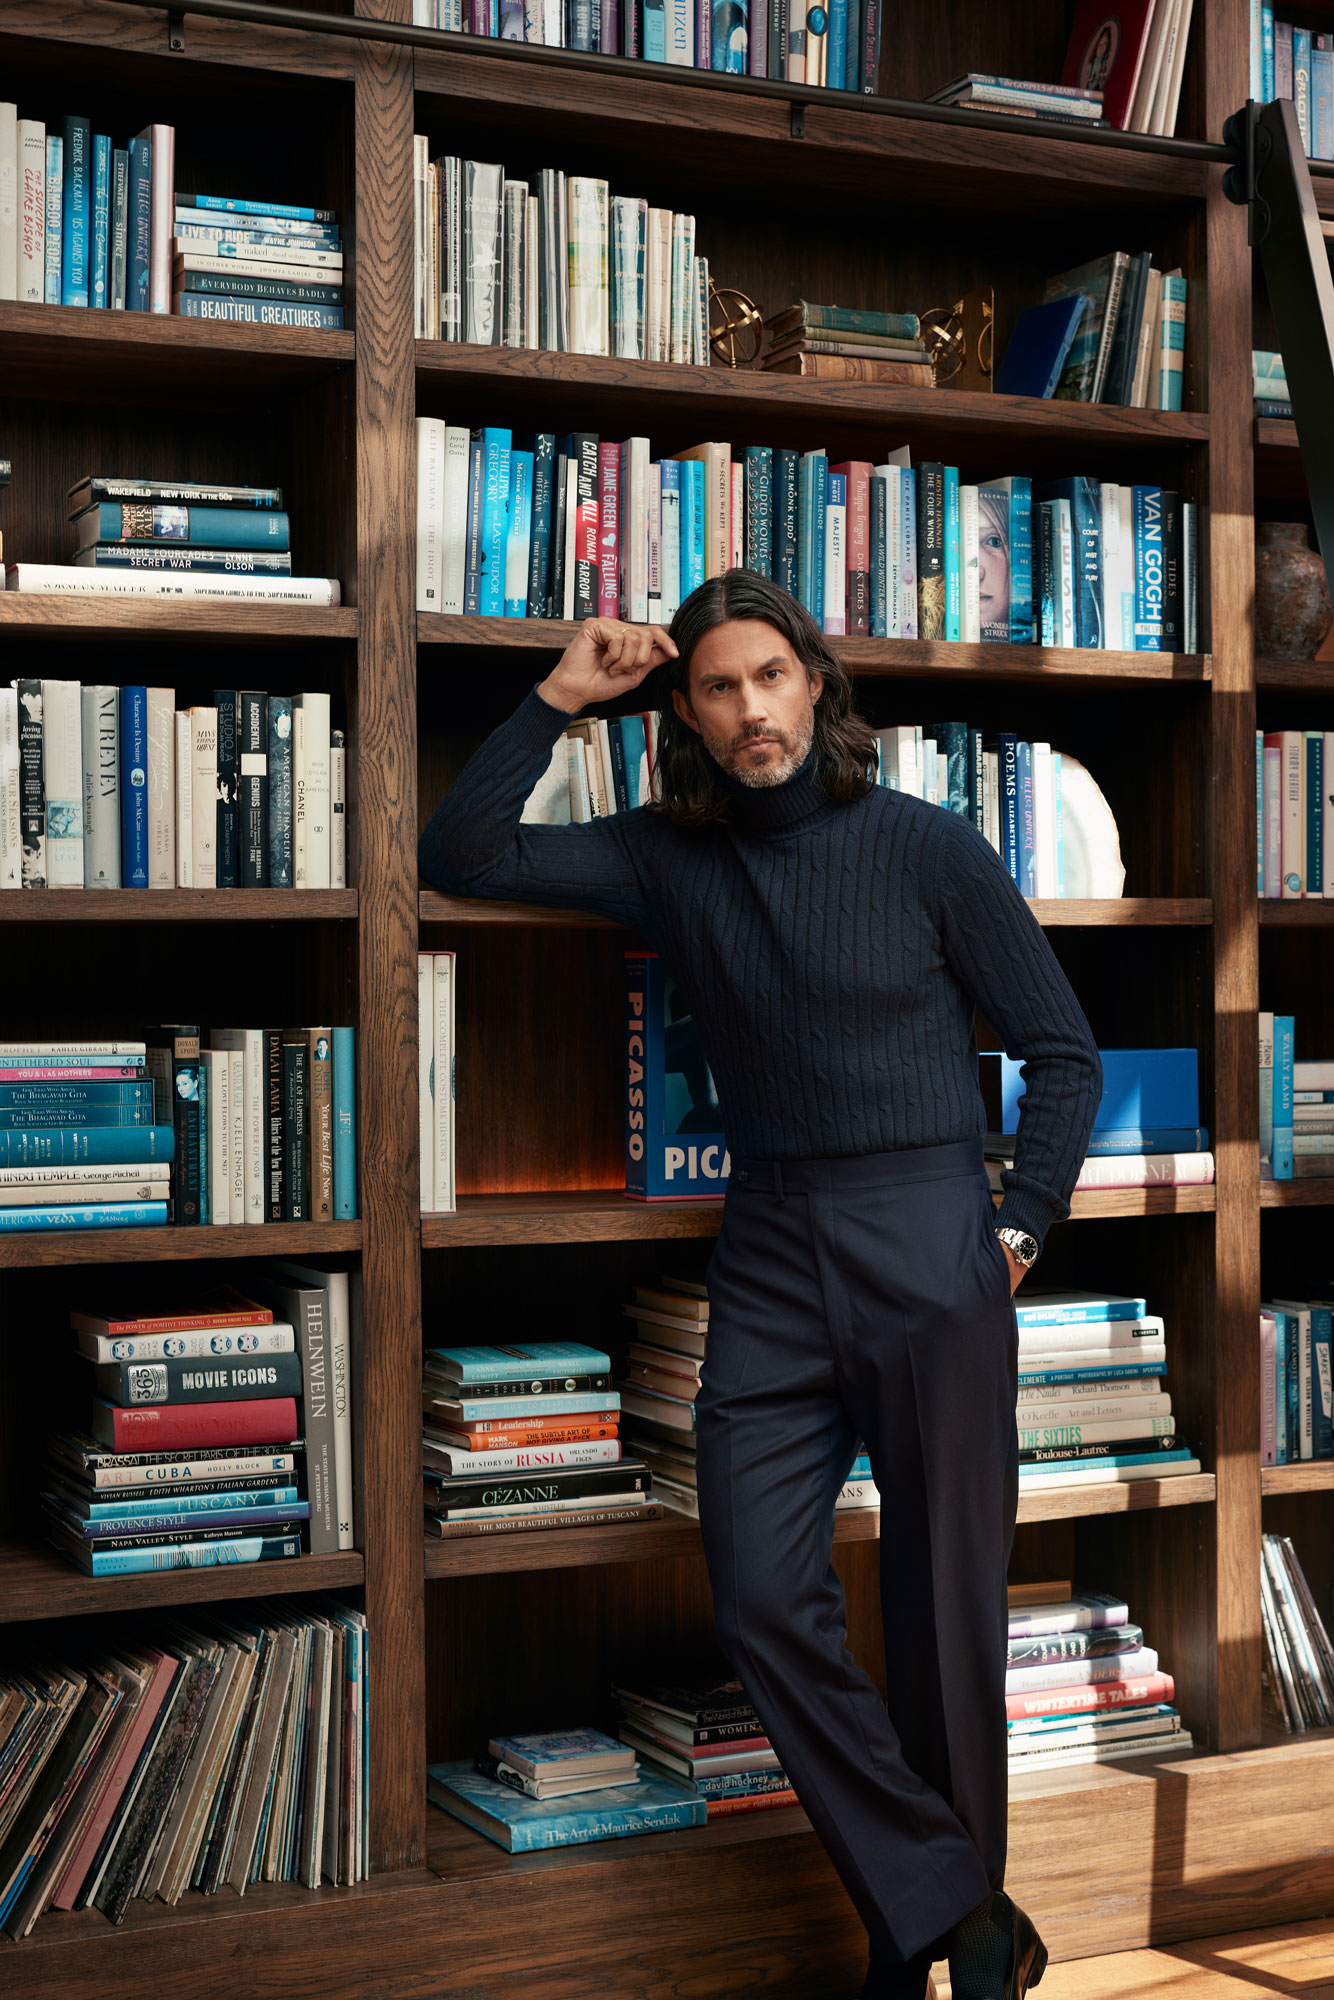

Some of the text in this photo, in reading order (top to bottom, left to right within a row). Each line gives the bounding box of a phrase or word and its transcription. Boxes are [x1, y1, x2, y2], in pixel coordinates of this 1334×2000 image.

[576, 6, 589, 39] ROVER
[73, 127, 84, 212] FREDRIK BACKMAN
[46, 175, 62, 278] BAMBOO PEOPLE
[182, 225, 249, 244] LIVE TO RIDE
[72, 218, 84, 285] US AGAINST YOU
[264, 236, 316, 249] WAYNE JOHNSON
[201, 279, 327, 299] EVERYBODY BEHAVES BADLY
[201, 300, 321, 328] BEAUTIFUL CREATURES
[487, 443, 500, 504] GREGORY
[498, 448, 510, 500] PHILIPPA
[579, 440, 598, 523] CATCH AND KILL
[107, 487, 152, 498] WAKEFIELD
[160, 489, 178, 499] NEW
[179, 489, 200, 500] YORK
[535, 471, 543, 512] HOFFMAN
[603, 466, 617, 528] JANE GREEN
[787, 483, 795, 512] MONK
[853, 480, 867, 512] Philippa
[759, 475, 769, 559] GILDED WOLVES
[817, 494, 825, 530] ALLENDE
[926, 472, 935, 550] THE FOUR WINDS
[786, 514, 794, 540] KIDD
[832, 516, 840, 557] MAJESTY
[131, 557, 192, 569] SECRET WAR
[225, 562, 254, 571] OLSON
[427, 525, 435, 581] THE IDIOT
[490, 522, 501, 595] LAST TUDOR
[579, 526, 597, 601] RONAN FARROW
[1144, 491, 1163, 621] VAN GOGH
[601, 553, 618, 600] FALLING
[1168, 559, 1177, 598] TIDES
[857, 581, 865, 610] TIDES
[133, 694, 141, 732] Character
[250, 702, 259, 751] ACCIDENTAL
[100, 696, 117, 799] NUREYEV
[133, 739, 141, 764] Destiny
[282, 747, 291, 807] AMERICAN
[1005, 742, 1016, 797] POEMS
[251, 777, 260, 808] GENIUS
[297, 779, 305, 824] CHANEL
[18, 1070, 34, 1079] YOU
[57, 1069, 92, 1077] MOTHERS
[270, 1036, 280, 1116] DALAI LAMA
[628, 992, 644, 1162] PICASSO
[1282, 1033, 1290, 1110] WALLY LAMB
[10, 1090, 87, 1100] THE BHAGAVAD GITA
[10, 1112, 87, 1123] THE BHAGAVAD GITA
[234, 1116, 242, 1200] KJELL ENHAGER
[35, 1169, 81, 1182] TEMPLE
[82, 1171, 112, 1182] George
[307, 1302, 327, 1420] HELNWEIN
[182, 1367, 278, 1390] MOVIE ICONS
[333, 1343, 347, 1419] WASHINGTON
[498, 1419, 544, 1431] Leadership
[540, 1431, 566, 1439] SUBTLE
[1021, 1426, 1082, 1449] THE SIXTIES
[461, 1461, 476, 1469] THE
[478, 1460, 504, 1468] STORY
[516, 1450, 565, 1468] RUSSIA
[488, 1441, 518, 1450] MANSON
[1033, 1445, 1110, 1461] Toulouse-Lautrec
[101, 1466, 192, 1485] ART CUBA
[207, 1462, 260, 1473] HOLLY BLOCK
[174, 1493, 260, 1512] TUSCANY
[481, 1485, 559, 1506] CÉZANNE
[99, 1515, 187, 1532] PROVENCE STYLE
[478, 1510, 640, 1532] THE MOST BEAUTIFUL VILLAGES OF TUSCANY
[111, 1533, 194, 1548] NAPA VALLEY STYLE
[1024, 1687, 1148, 1714] WINTERTIME TALES
[718, 1723, 757, 1736] WOMEN
[705, 1775, 769, 1792] david hockney
[545, 1830, 569, 1844] The
[570, 1827, 587, 1839] Art
[601, 1820, 642, 1835] Maurice
[641, 1814, 680, 1828] Sendak
